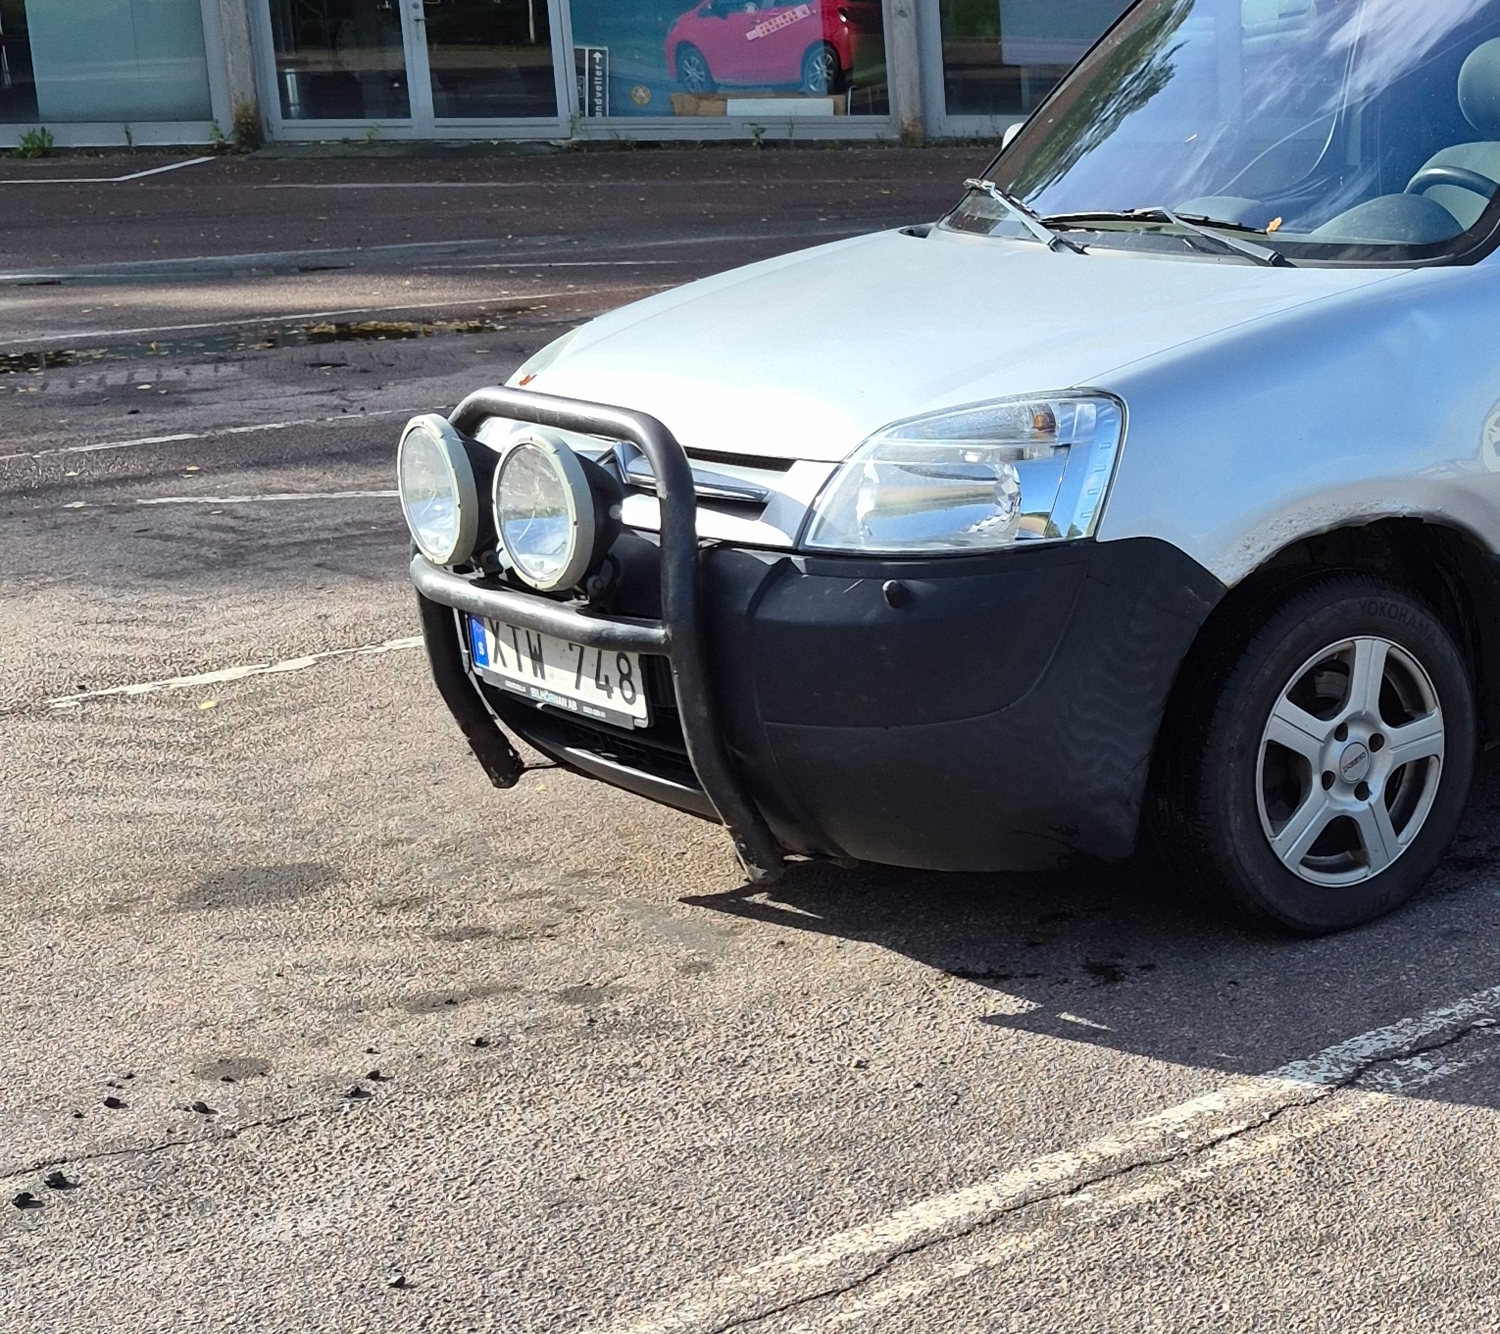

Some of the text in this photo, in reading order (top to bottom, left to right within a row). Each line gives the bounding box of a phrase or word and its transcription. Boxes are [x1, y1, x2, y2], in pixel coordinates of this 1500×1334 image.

[1358, 600, 1438, 643] YOKOHAMA
[477, 641, 485, 656] S
[488, 617, 637, 706] XTW 748
